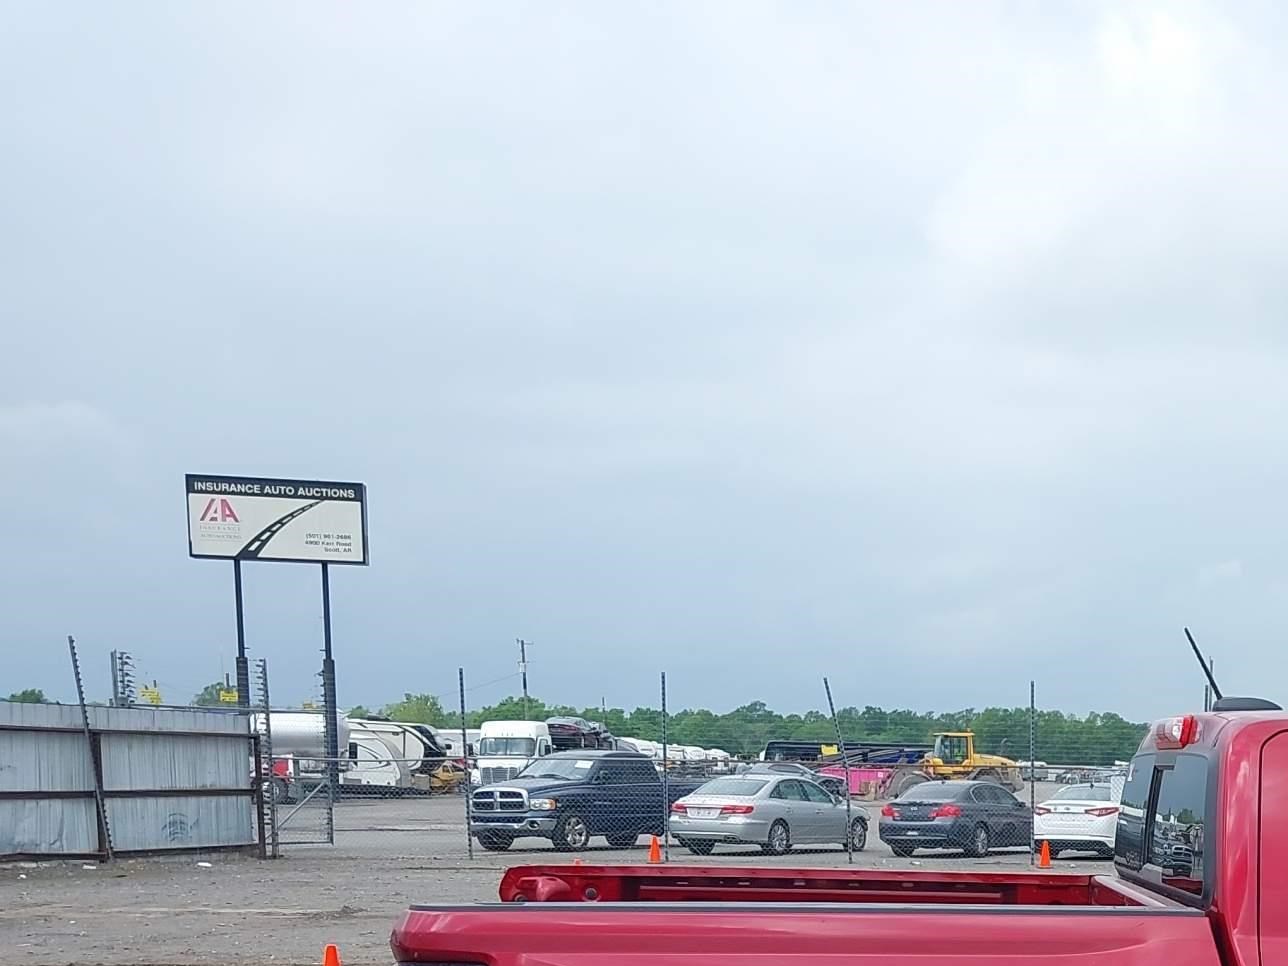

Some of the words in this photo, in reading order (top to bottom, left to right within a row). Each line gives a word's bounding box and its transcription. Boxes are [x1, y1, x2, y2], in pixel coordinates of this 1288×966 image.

[194, 481, 261, 494] INSURANCE
[263, 487, 295, 496] AUTO
[297, 487, 355, 499] AUCTIONS
